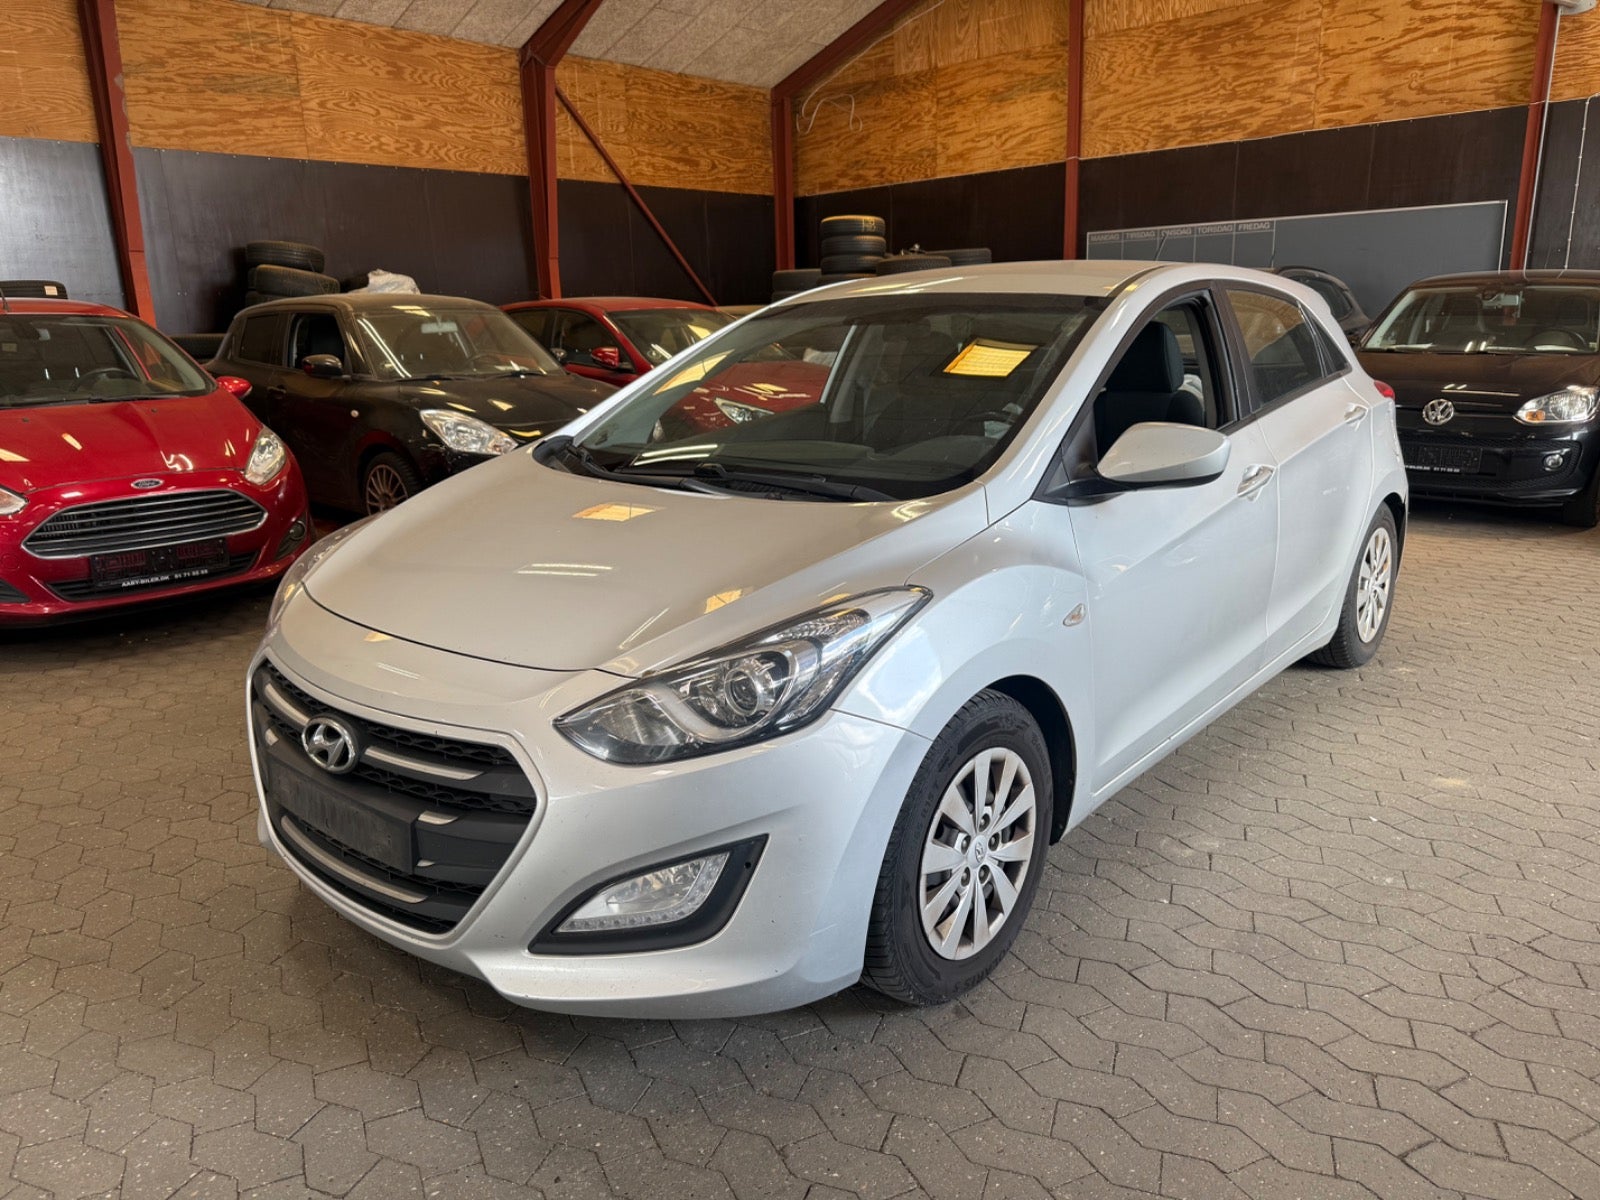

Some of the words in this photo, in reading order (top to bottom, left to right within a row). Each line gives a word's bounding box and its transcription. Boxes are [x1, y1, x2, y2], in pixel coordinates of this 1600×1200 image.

[1090, 233, 1120, 241] MANDAG
[1126, 230, 1156, 240] TIRSDAG
[1197, 224, 1233, 235] TORSDAG
[1238, 221, 1271, 232] FREDAG
